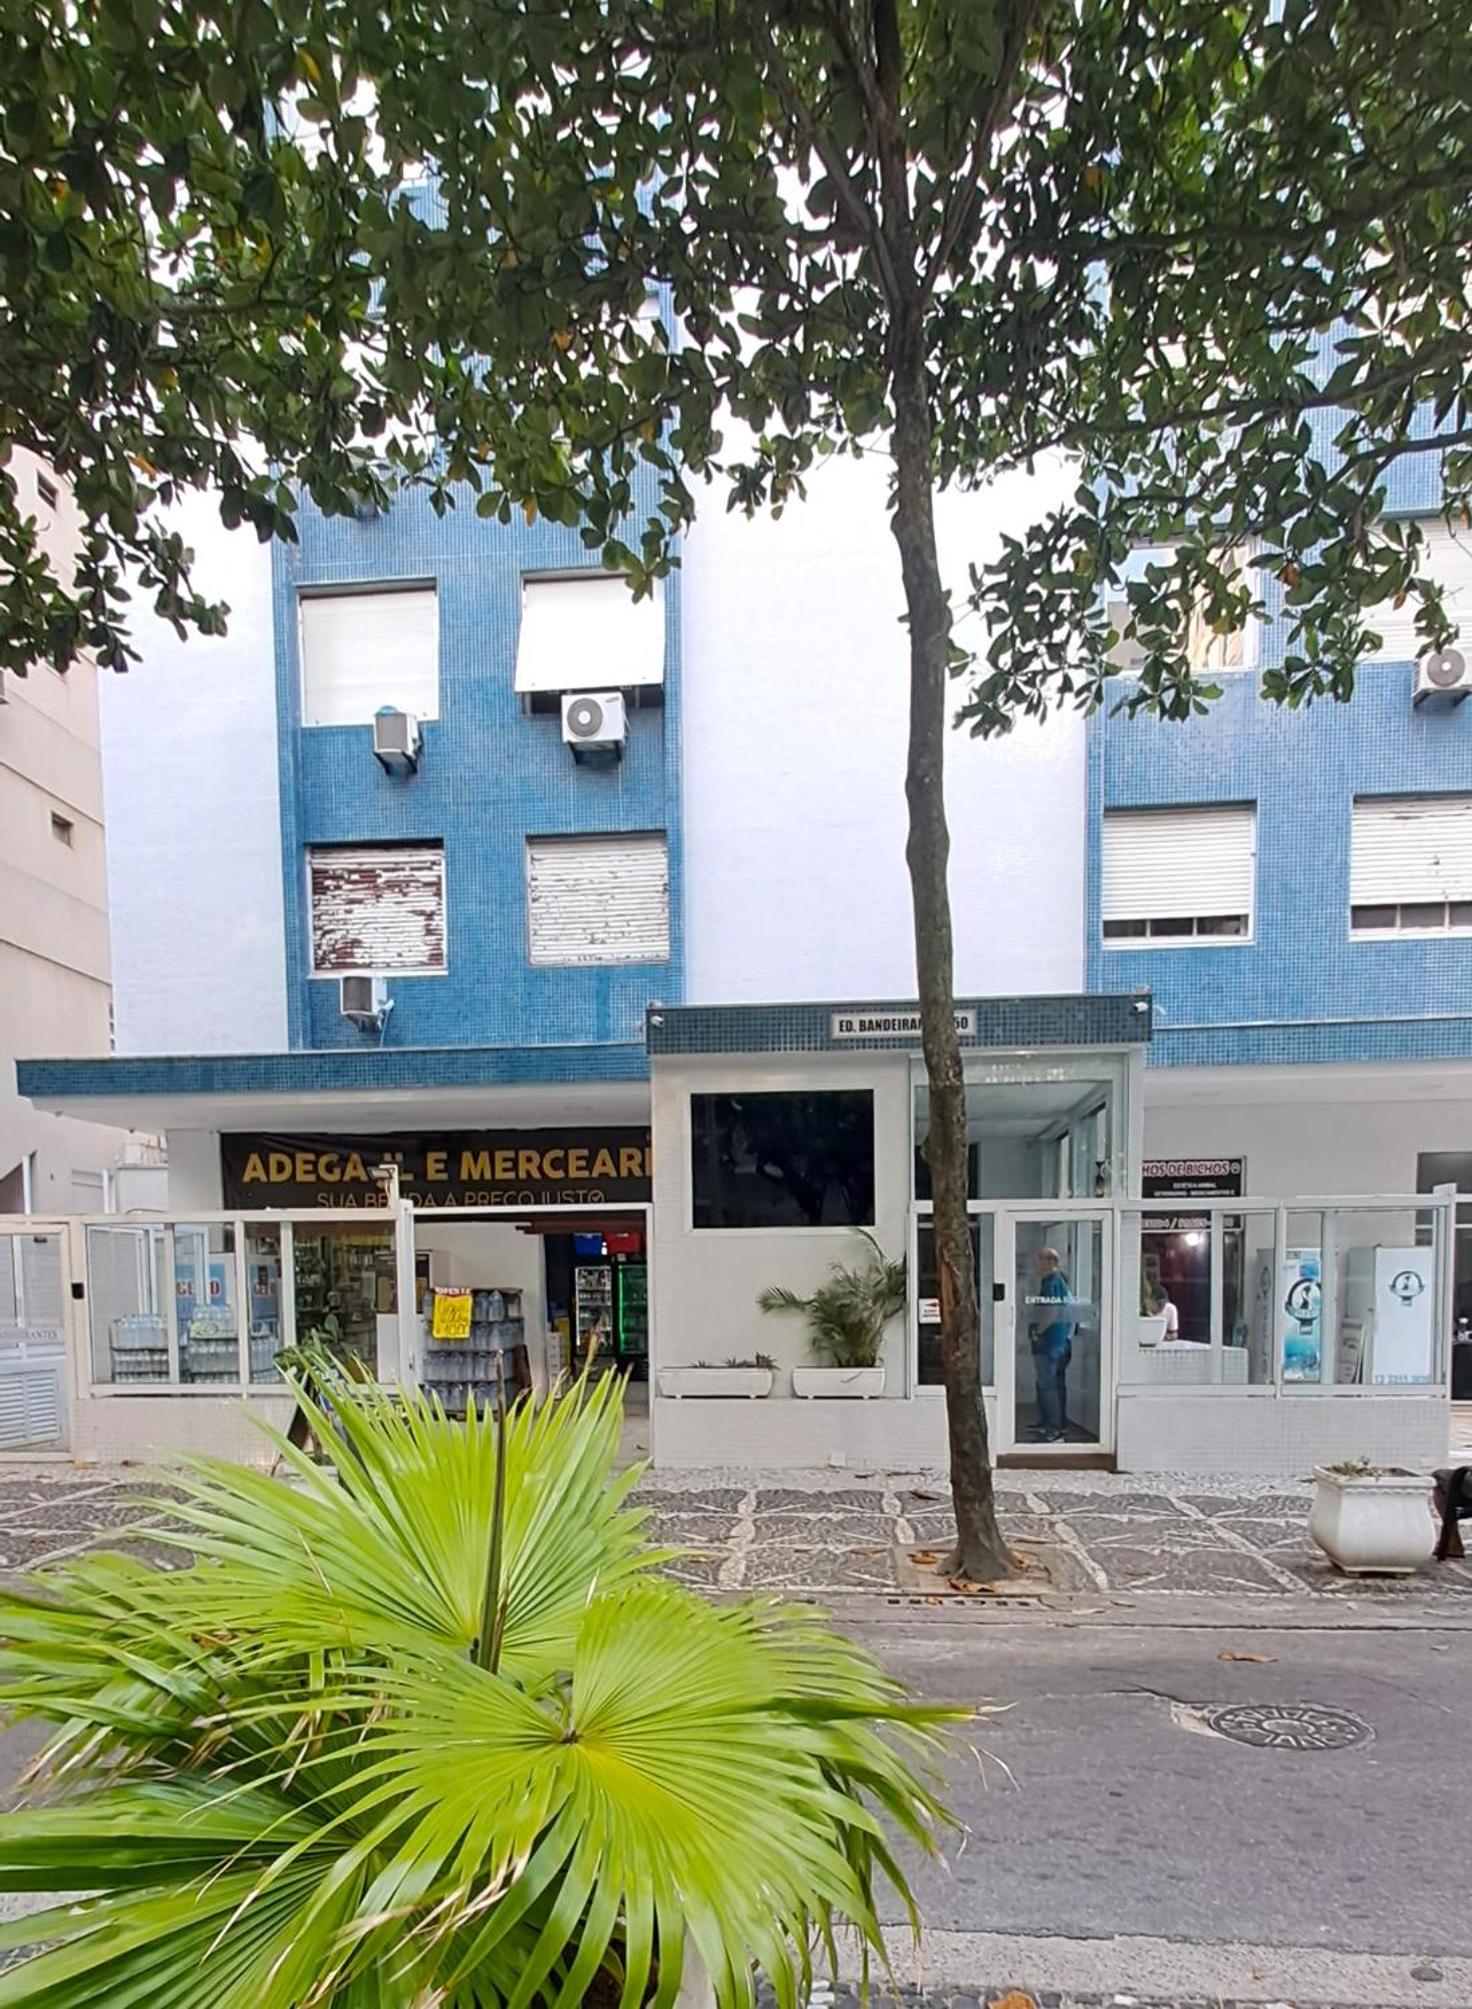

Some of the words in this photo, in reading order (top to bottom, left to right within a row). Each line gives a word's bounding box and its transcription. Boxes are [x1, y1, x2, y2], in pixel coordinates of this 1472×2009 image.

[839, 1018, 856, 1033] ED.
[242, 1151, 368, 1183] ADEGA
[426, 1150, 449, 1182] E
[1167, 1161, 1185, 1177] DE
[1185, 1160, 1230, 1177] BICHOS
[443, 1191, 458, 1208] A
[1024, 1295, 1062, 1305] ENTRADA
